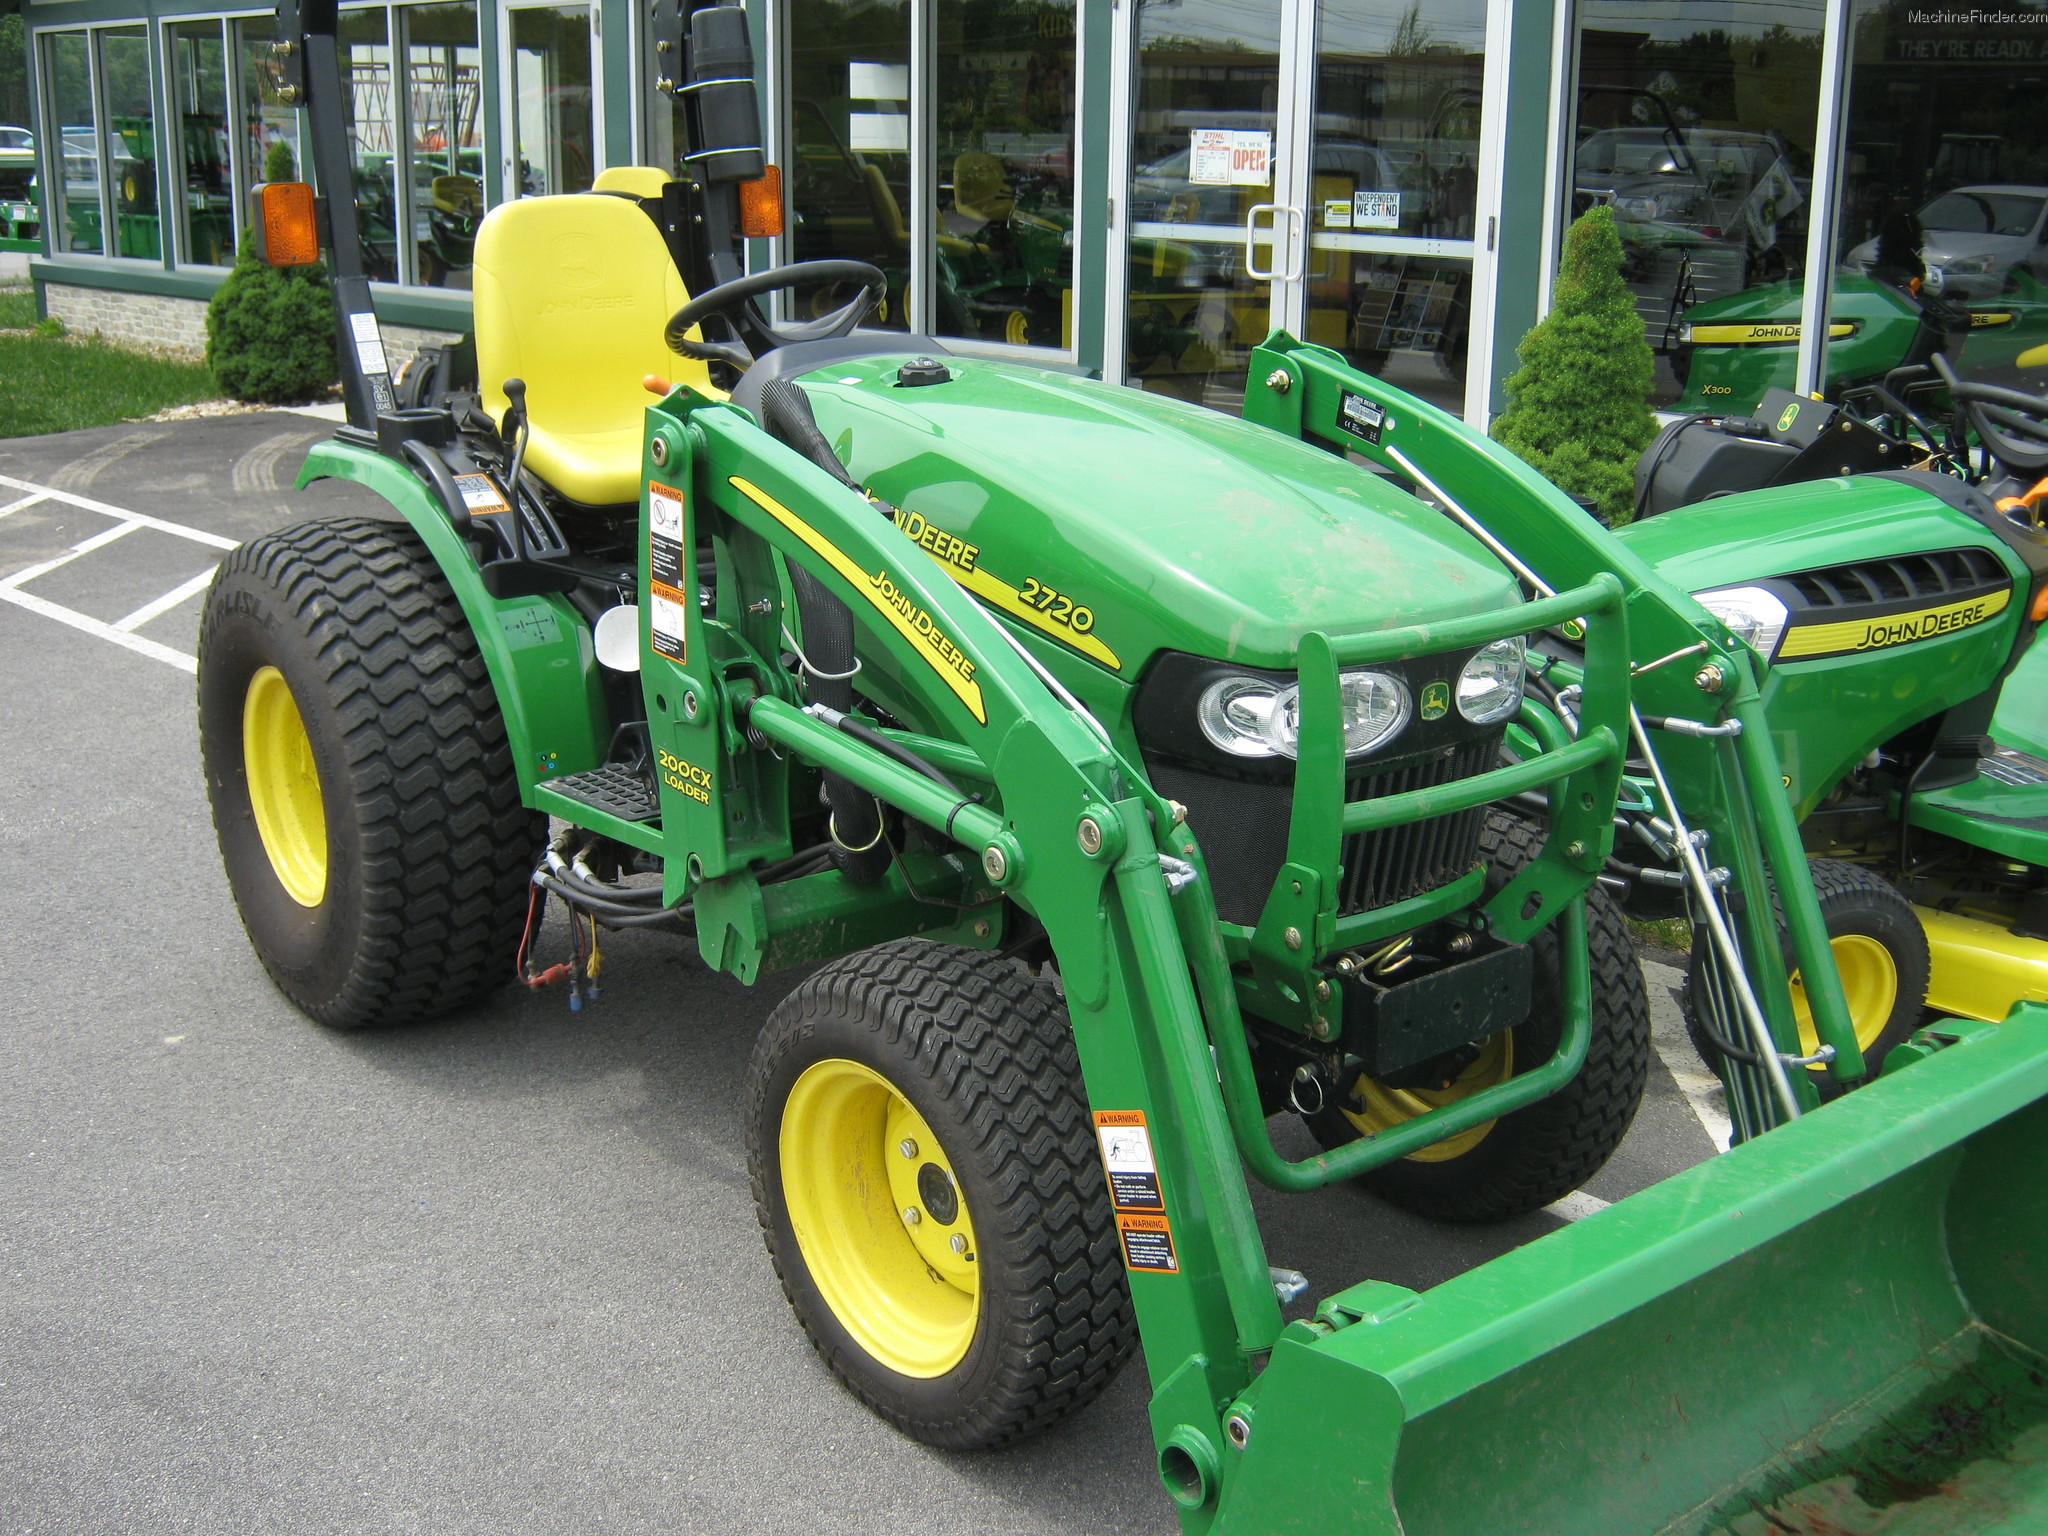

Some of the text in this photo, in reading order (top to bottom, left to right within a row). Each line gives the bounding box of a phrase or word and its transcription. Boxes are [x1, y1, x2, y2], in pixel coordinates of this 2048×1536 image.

[1898, 40, 1970, 58] THEY'RE
[1204, 131, 1225, 140] STIHL
[1233, 149, 1266, 171] OPEN
[1356, 193, 1398, 204] INDEPENDENT
[1355, 203, 1369, 215] WE
[581, 294, 636, 310] DEERE
[1748, 326, 1785, 338] JOHN
[1702, 384, 1732, 395] X300
[656, 485, 682, 502] WARNING
[864, 487, 980, 572] JN DEERE
[657, 587, 684, 605] WARNING
[1018, 577, 1094, 634] 2720
[868, 569, 977, 681] JOHN DEERE
[1857, 603, 1986, 648] JOHN DEERE
[658, 749, 712, 791] 200CX
[664, 771, 710, 806] LOADER
[1107, 1114, 1140, 1123] WARNING
[1131, 1219, 1164, 1229] WARNING
